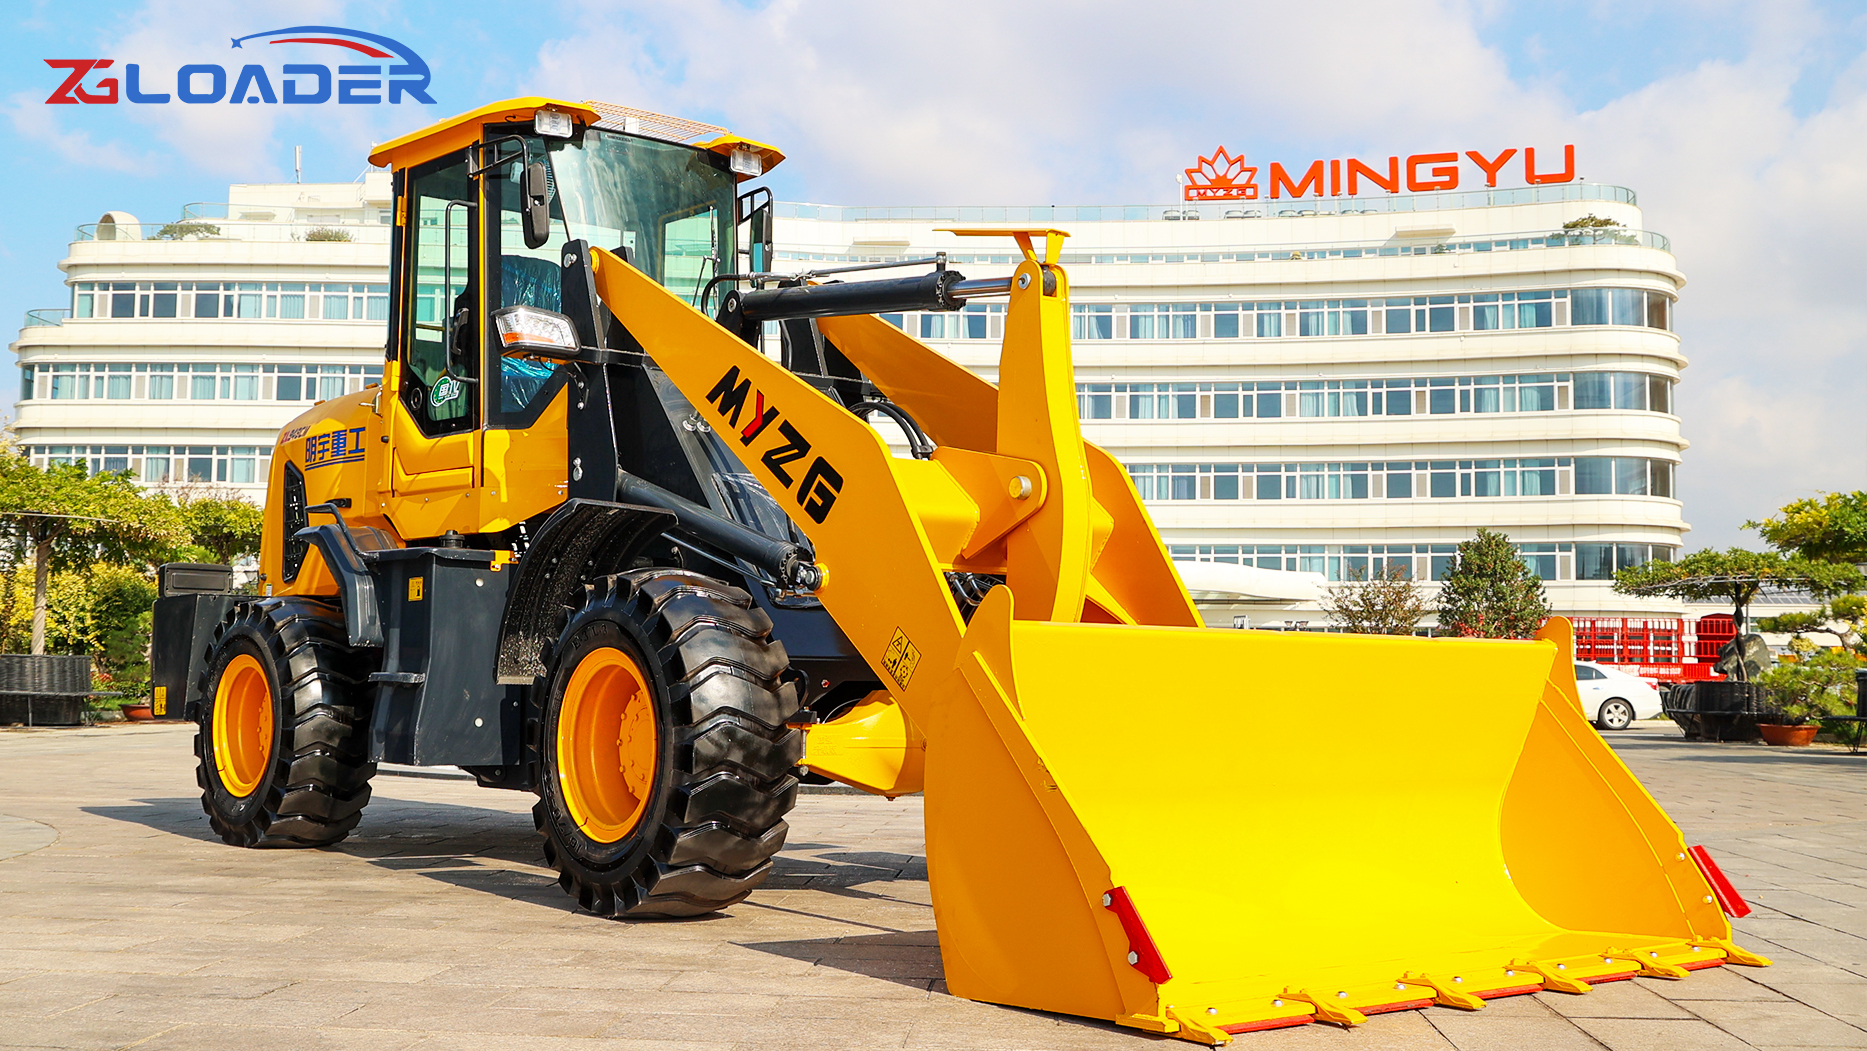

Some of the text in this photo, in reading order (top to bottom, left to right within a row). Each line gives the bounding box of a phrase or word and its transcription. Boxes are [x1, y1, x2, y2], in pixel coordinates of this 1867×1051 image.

[1270, 144, 1575, 199] MINGYU
[305, 427, 366, 463] 明宇重工
[705, 365, 844, 524] MYZG
